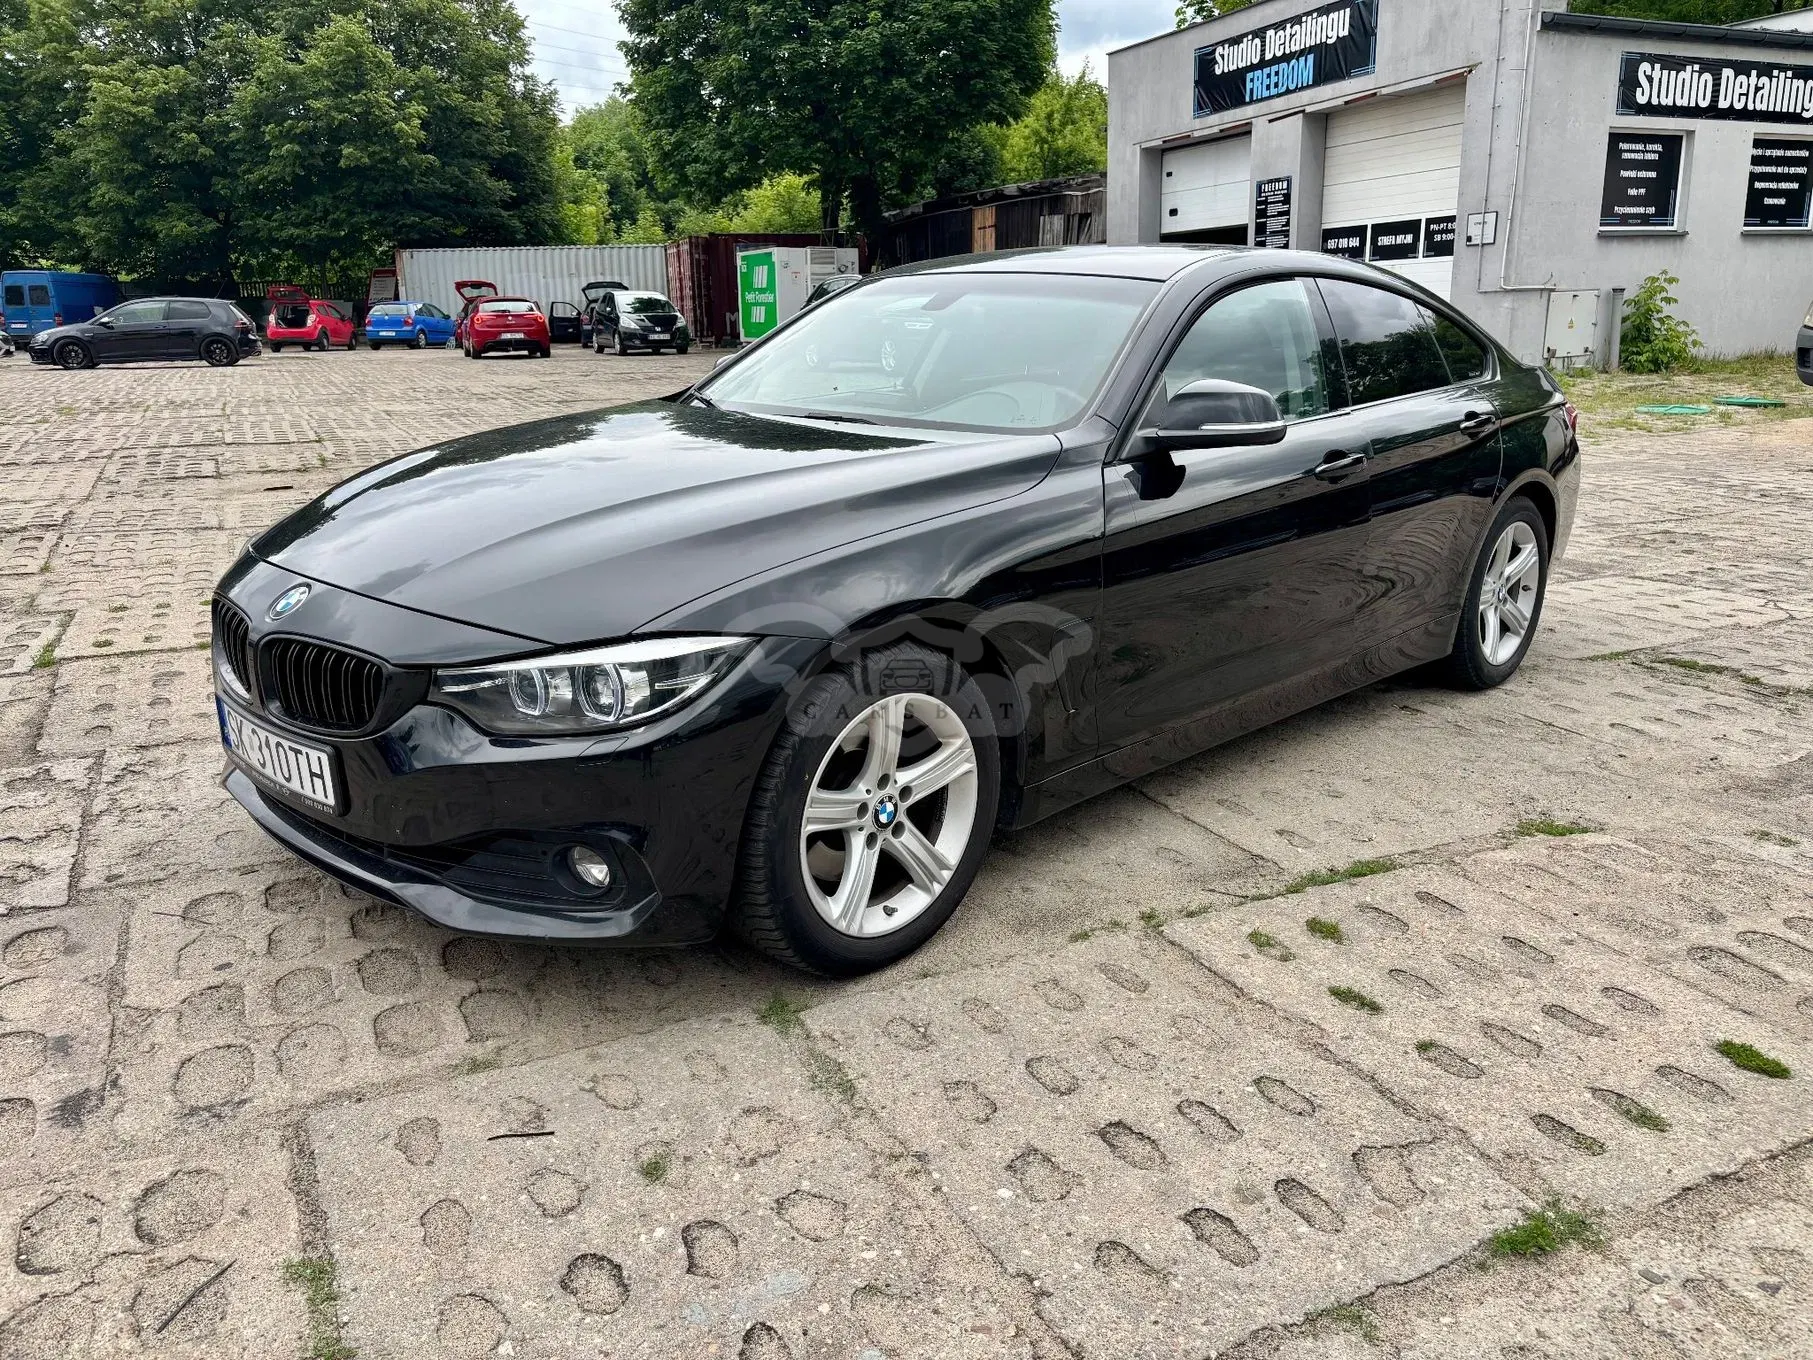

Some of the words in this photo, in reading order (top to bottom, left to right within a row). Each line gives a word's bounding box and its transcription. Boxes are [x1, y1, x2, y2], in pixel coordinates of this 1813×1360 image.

[1214, 34, 1261, 75] Studio
[1265, 7, 1350, 61] Detailingu
[1245, 53, 1315, 102] FREEDOM
[1635, 61, 1713, 108] Studio
[1327, 239, 1338, 249] 697
[1377, 236, 1395, 246] STREFA
[1430, 223, 1447, 231] PN-PT
[227, 709, 252, 761] SK
[251, 727, 329, 800] 310TH
